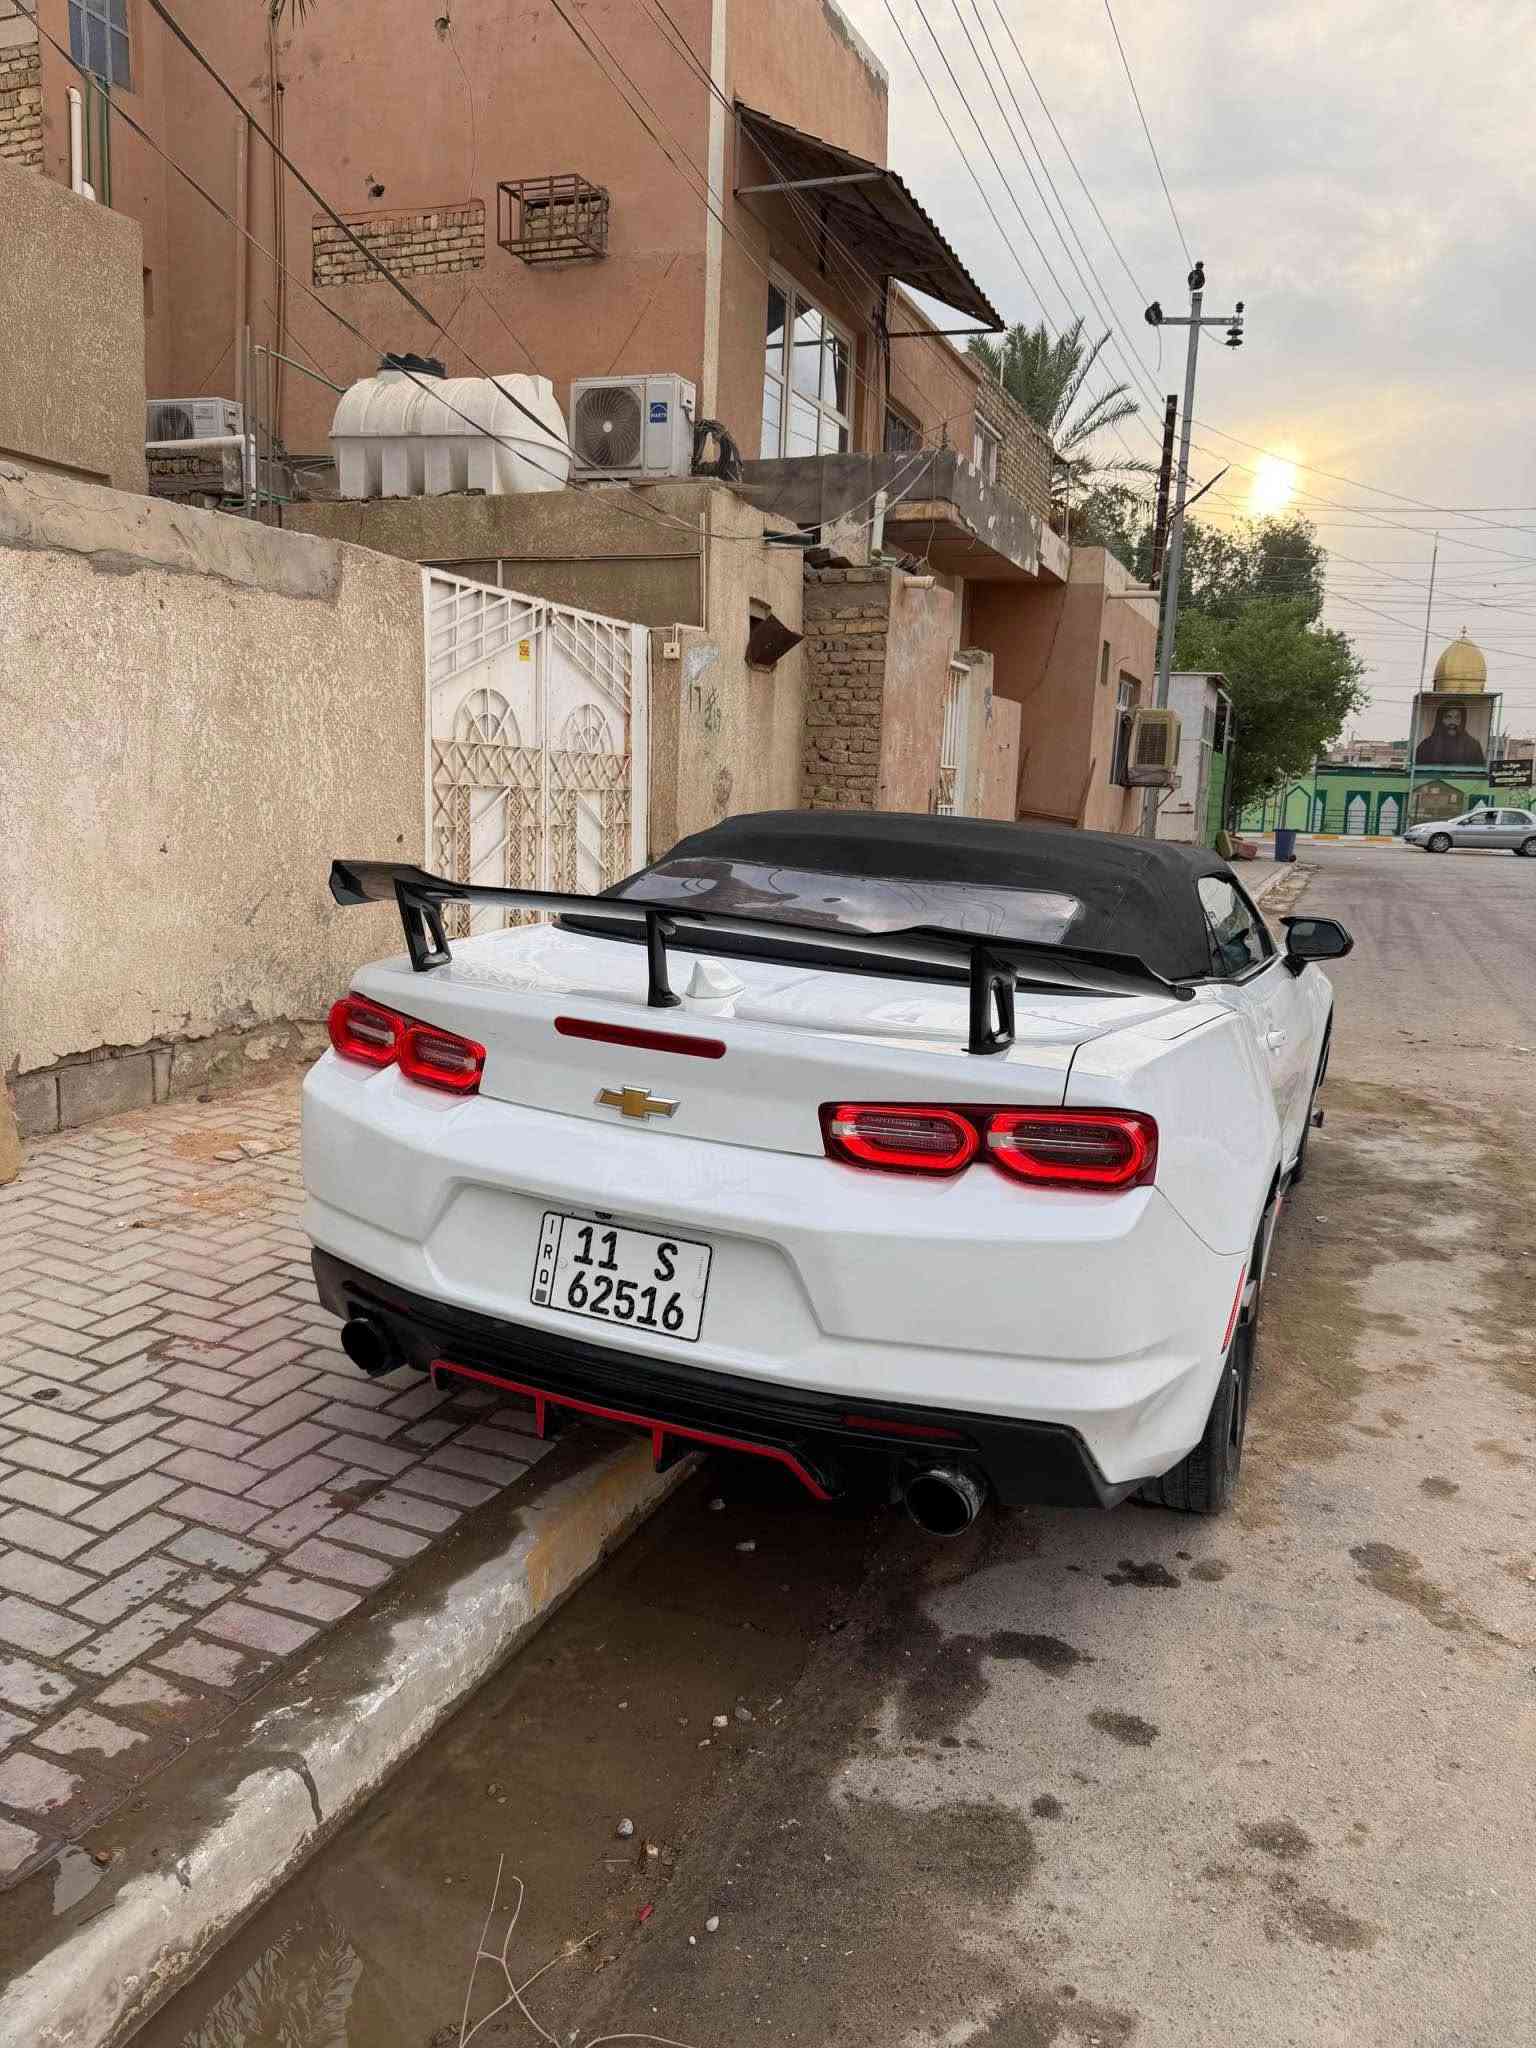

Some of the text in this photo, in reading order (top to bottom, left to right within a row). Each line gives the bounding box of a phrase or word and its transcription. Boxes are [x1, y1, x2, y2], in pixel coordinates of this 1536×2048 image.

[573, 1226, 618, 1271] 11
[653, 1242, 679, 1282] S
[567, 1270, 685, 1331] 62516
